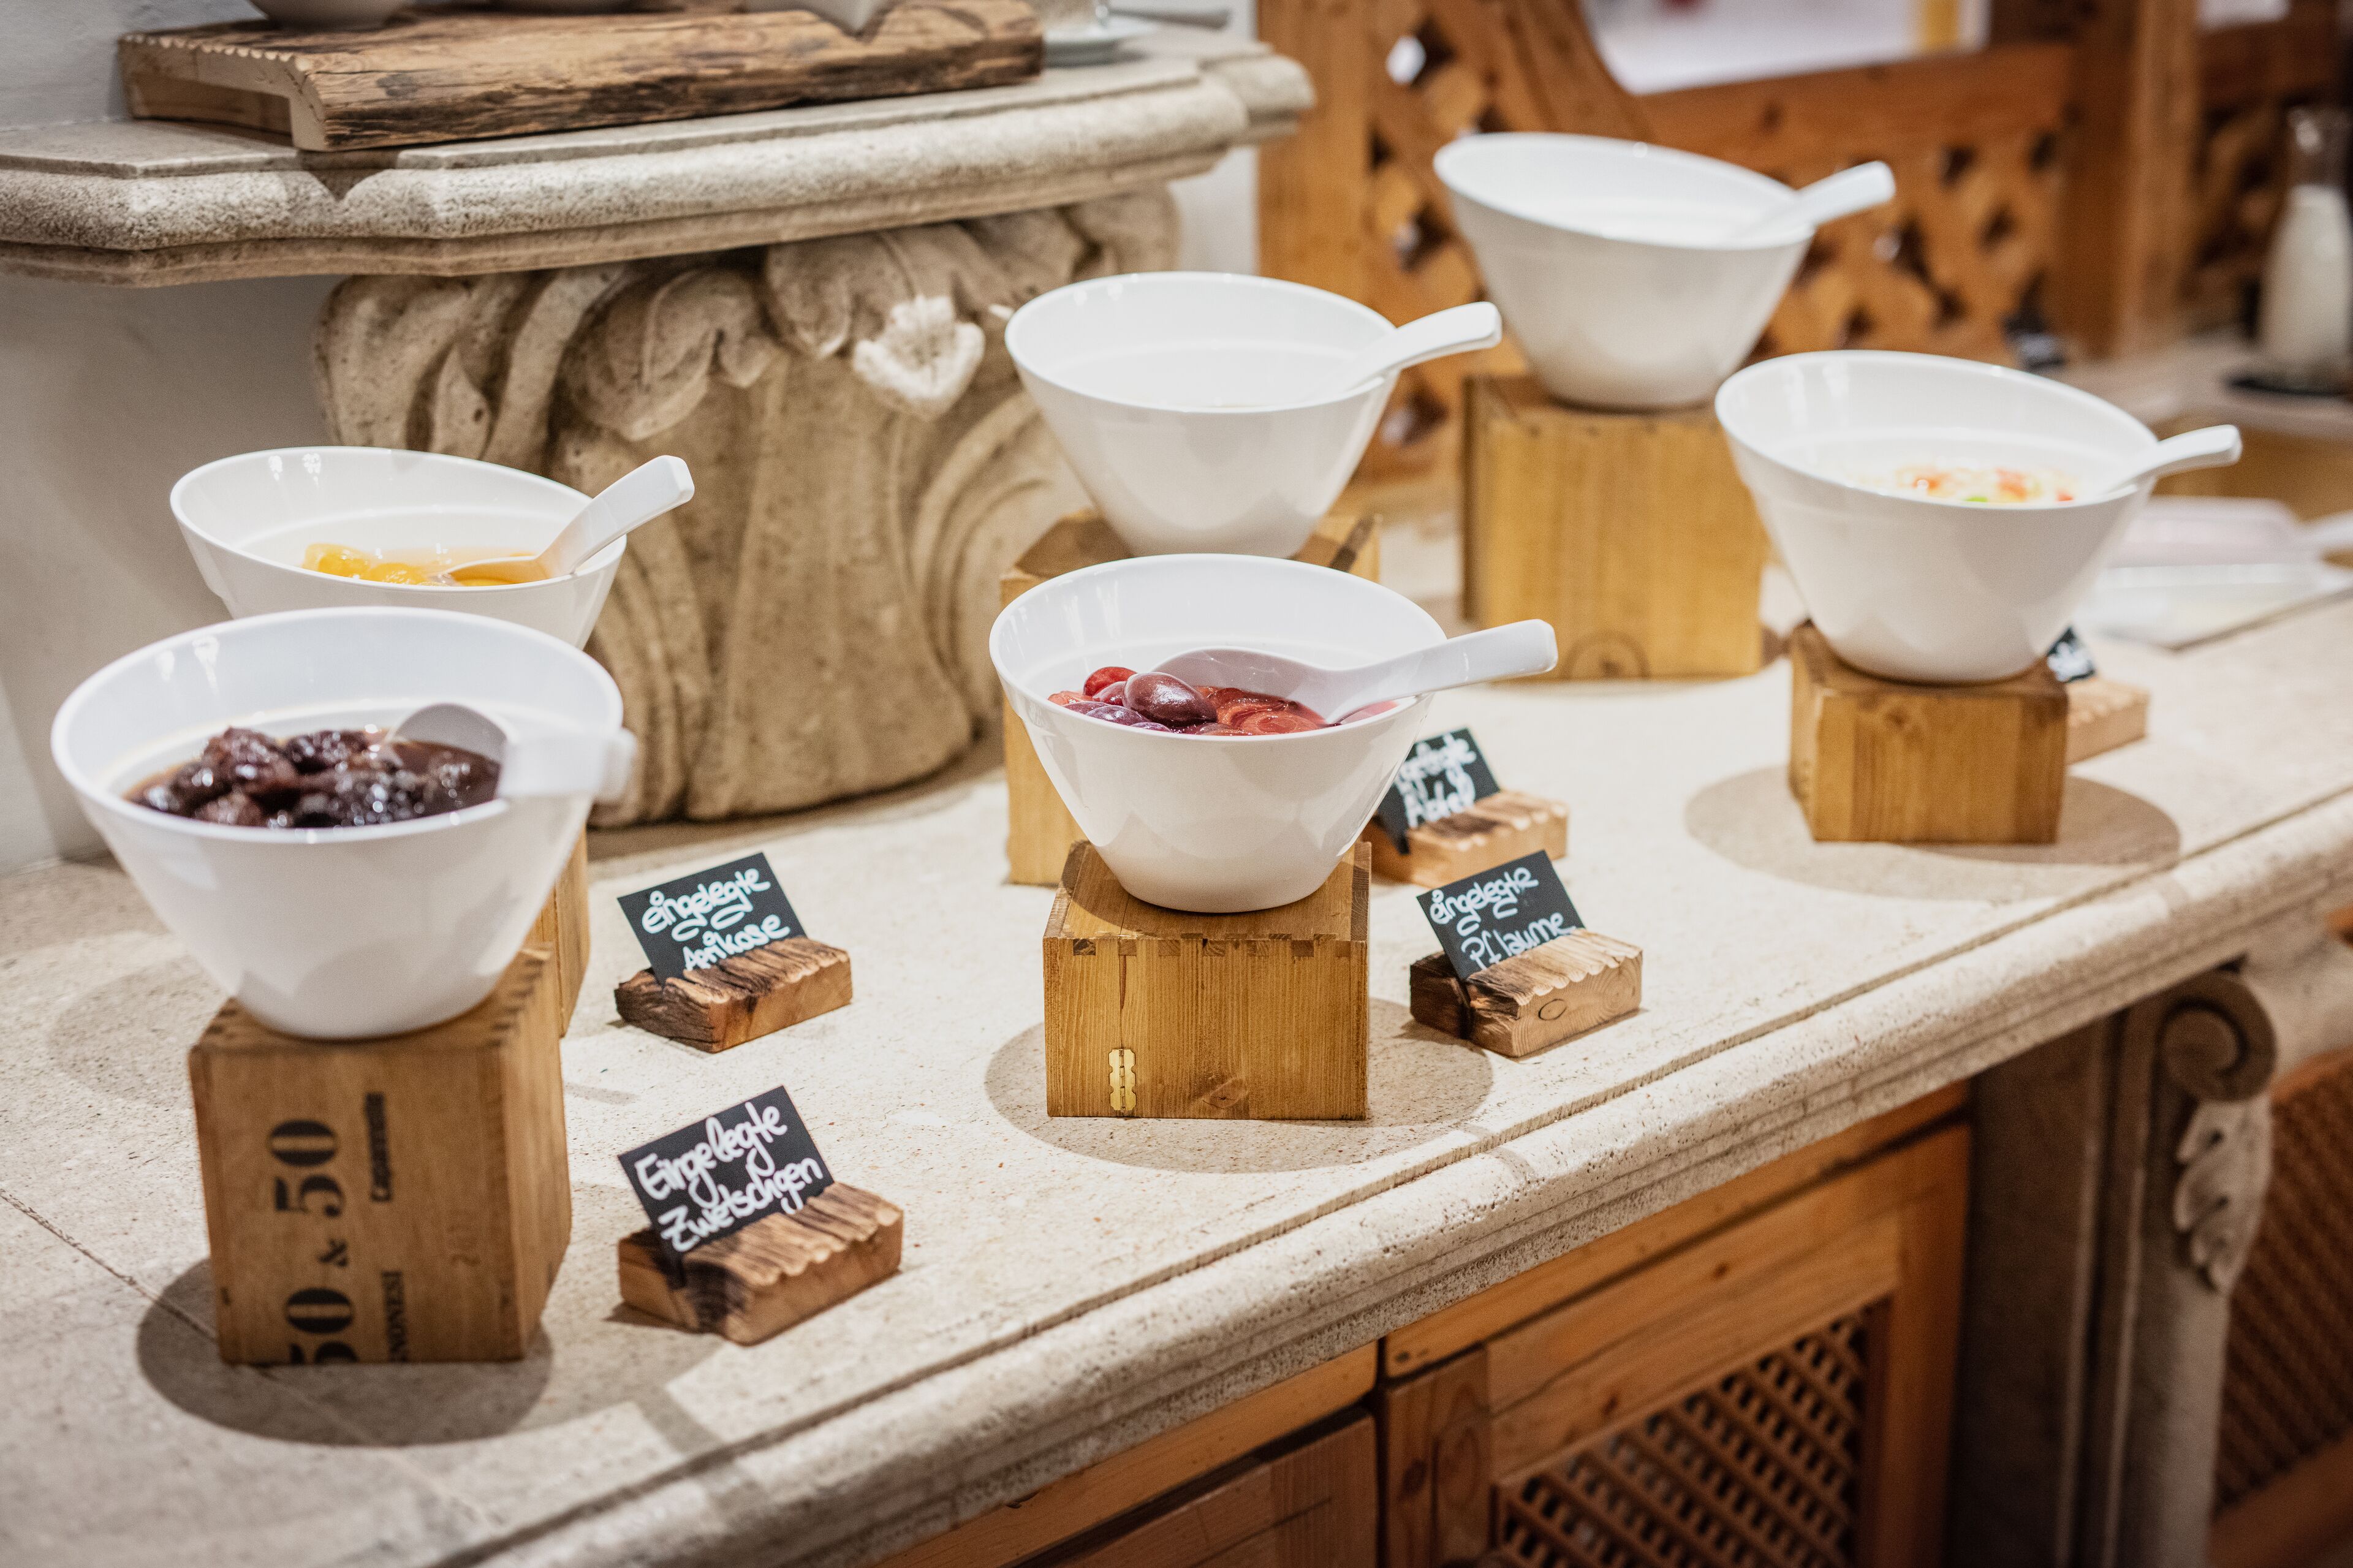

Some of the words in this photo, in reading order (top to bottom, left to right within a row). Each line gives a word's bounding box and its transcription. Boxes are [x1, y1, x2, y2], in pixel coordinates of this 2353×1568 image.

[682, 914, 791, 971] Aprikose
[1460, 912, 1577, 971] Pflaume
[267, 1118, 344, 1218] 50
[634, 1102, 789, 1210] Eingelegte
[657, 1156, 824, 1252] Zwetschgen
[317, 1238, 349, 1268] &
